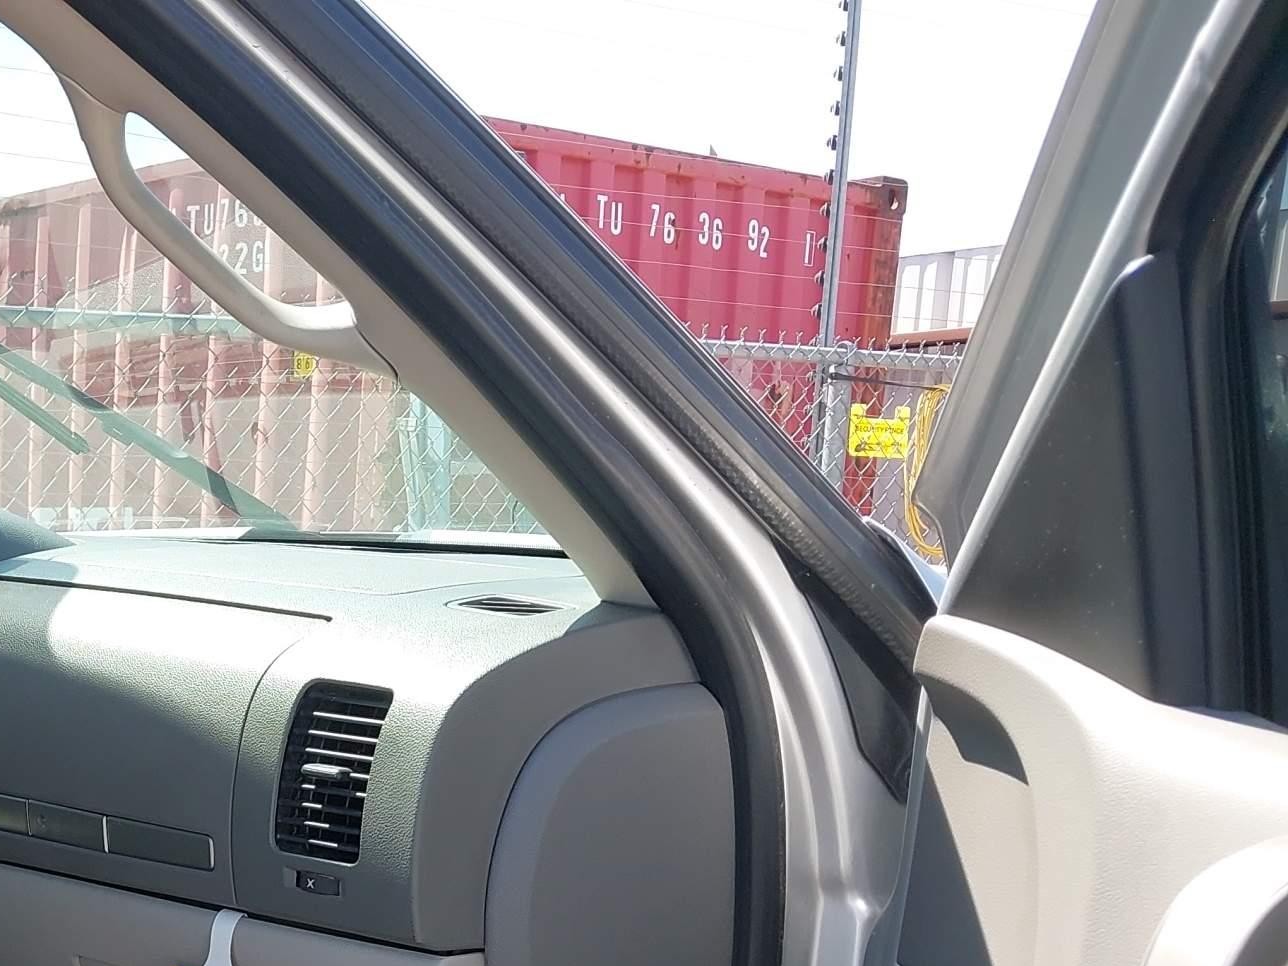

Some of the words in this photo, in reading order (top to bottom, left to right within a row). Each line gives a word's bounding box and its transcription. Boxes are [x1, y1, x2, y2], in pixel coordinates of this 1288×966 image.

[597, 194, 623, 235] TU
[649, 203, 676, 244] 76
[698, 212, 722, 250] 36
[748, 219, 770, 258] 92
